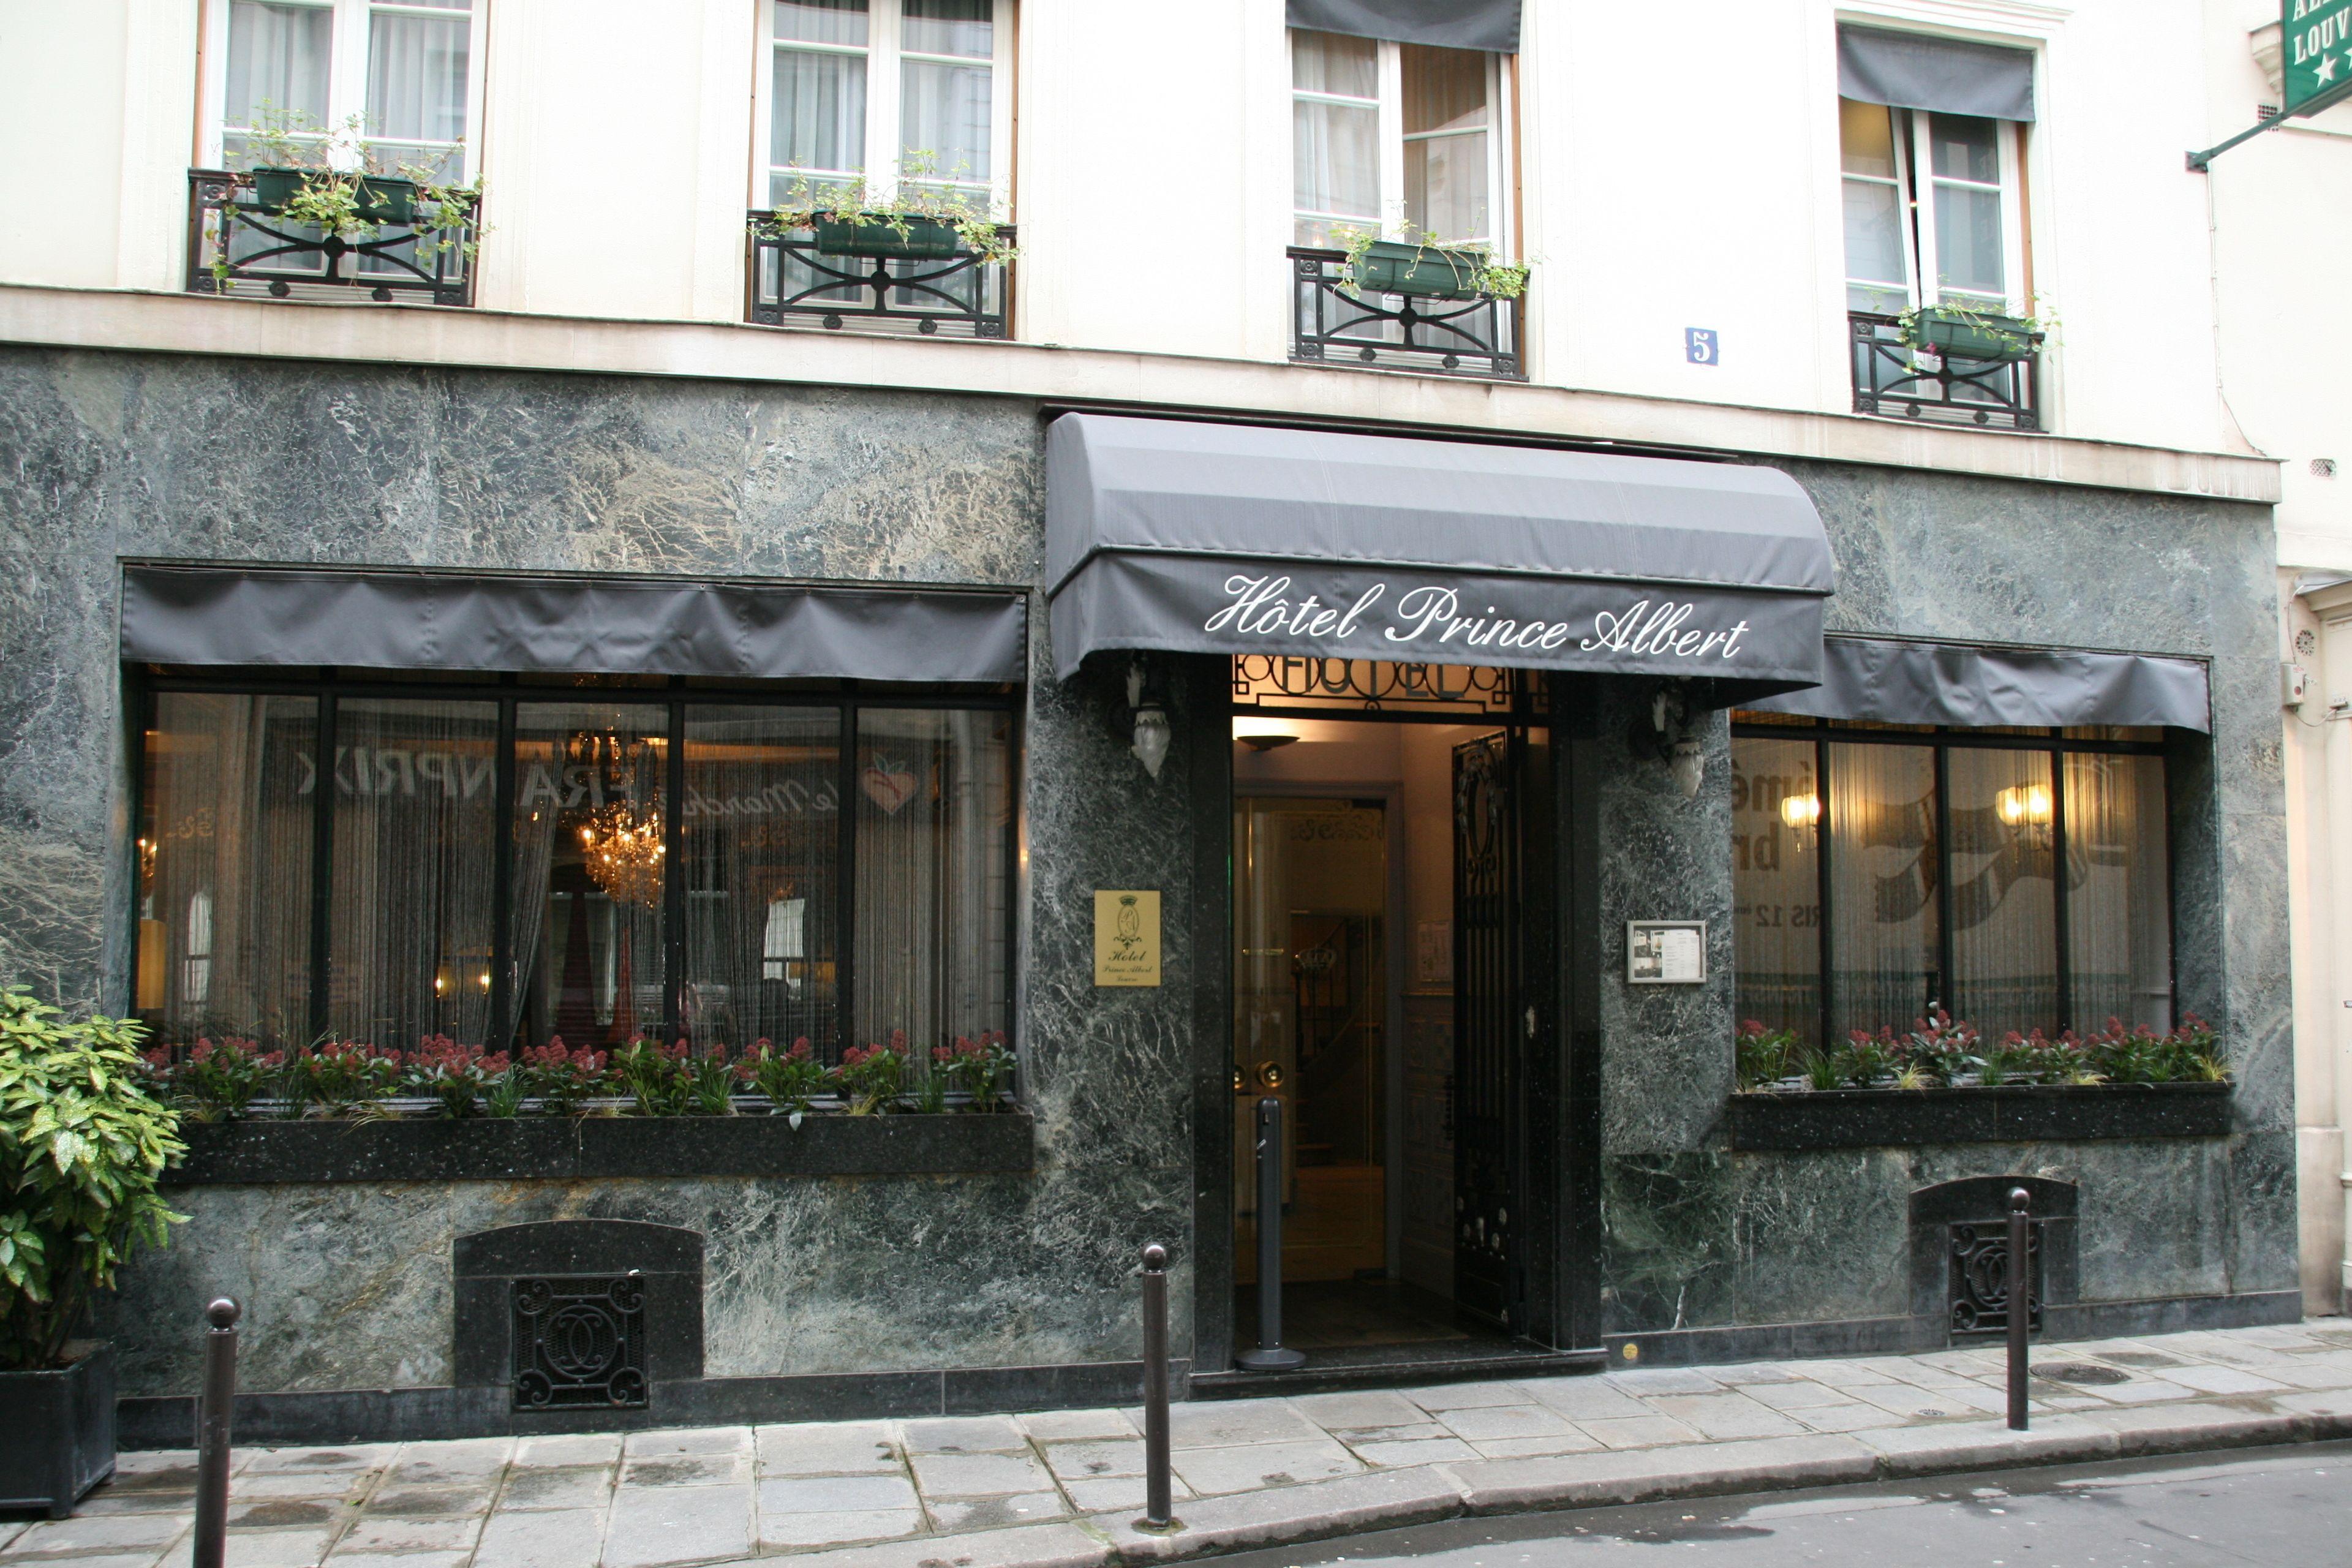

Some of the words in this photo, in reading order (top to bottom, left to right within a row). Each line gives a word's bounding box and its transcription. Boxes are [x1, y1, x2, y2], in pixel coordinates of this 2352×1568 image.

[1693, 331, 1710, 362] 5
[1204, 575, 1385, 638] Hôtel
[1385, 586, 1568, 649] Prince
[1580, 600, 1749, 658] Albert
